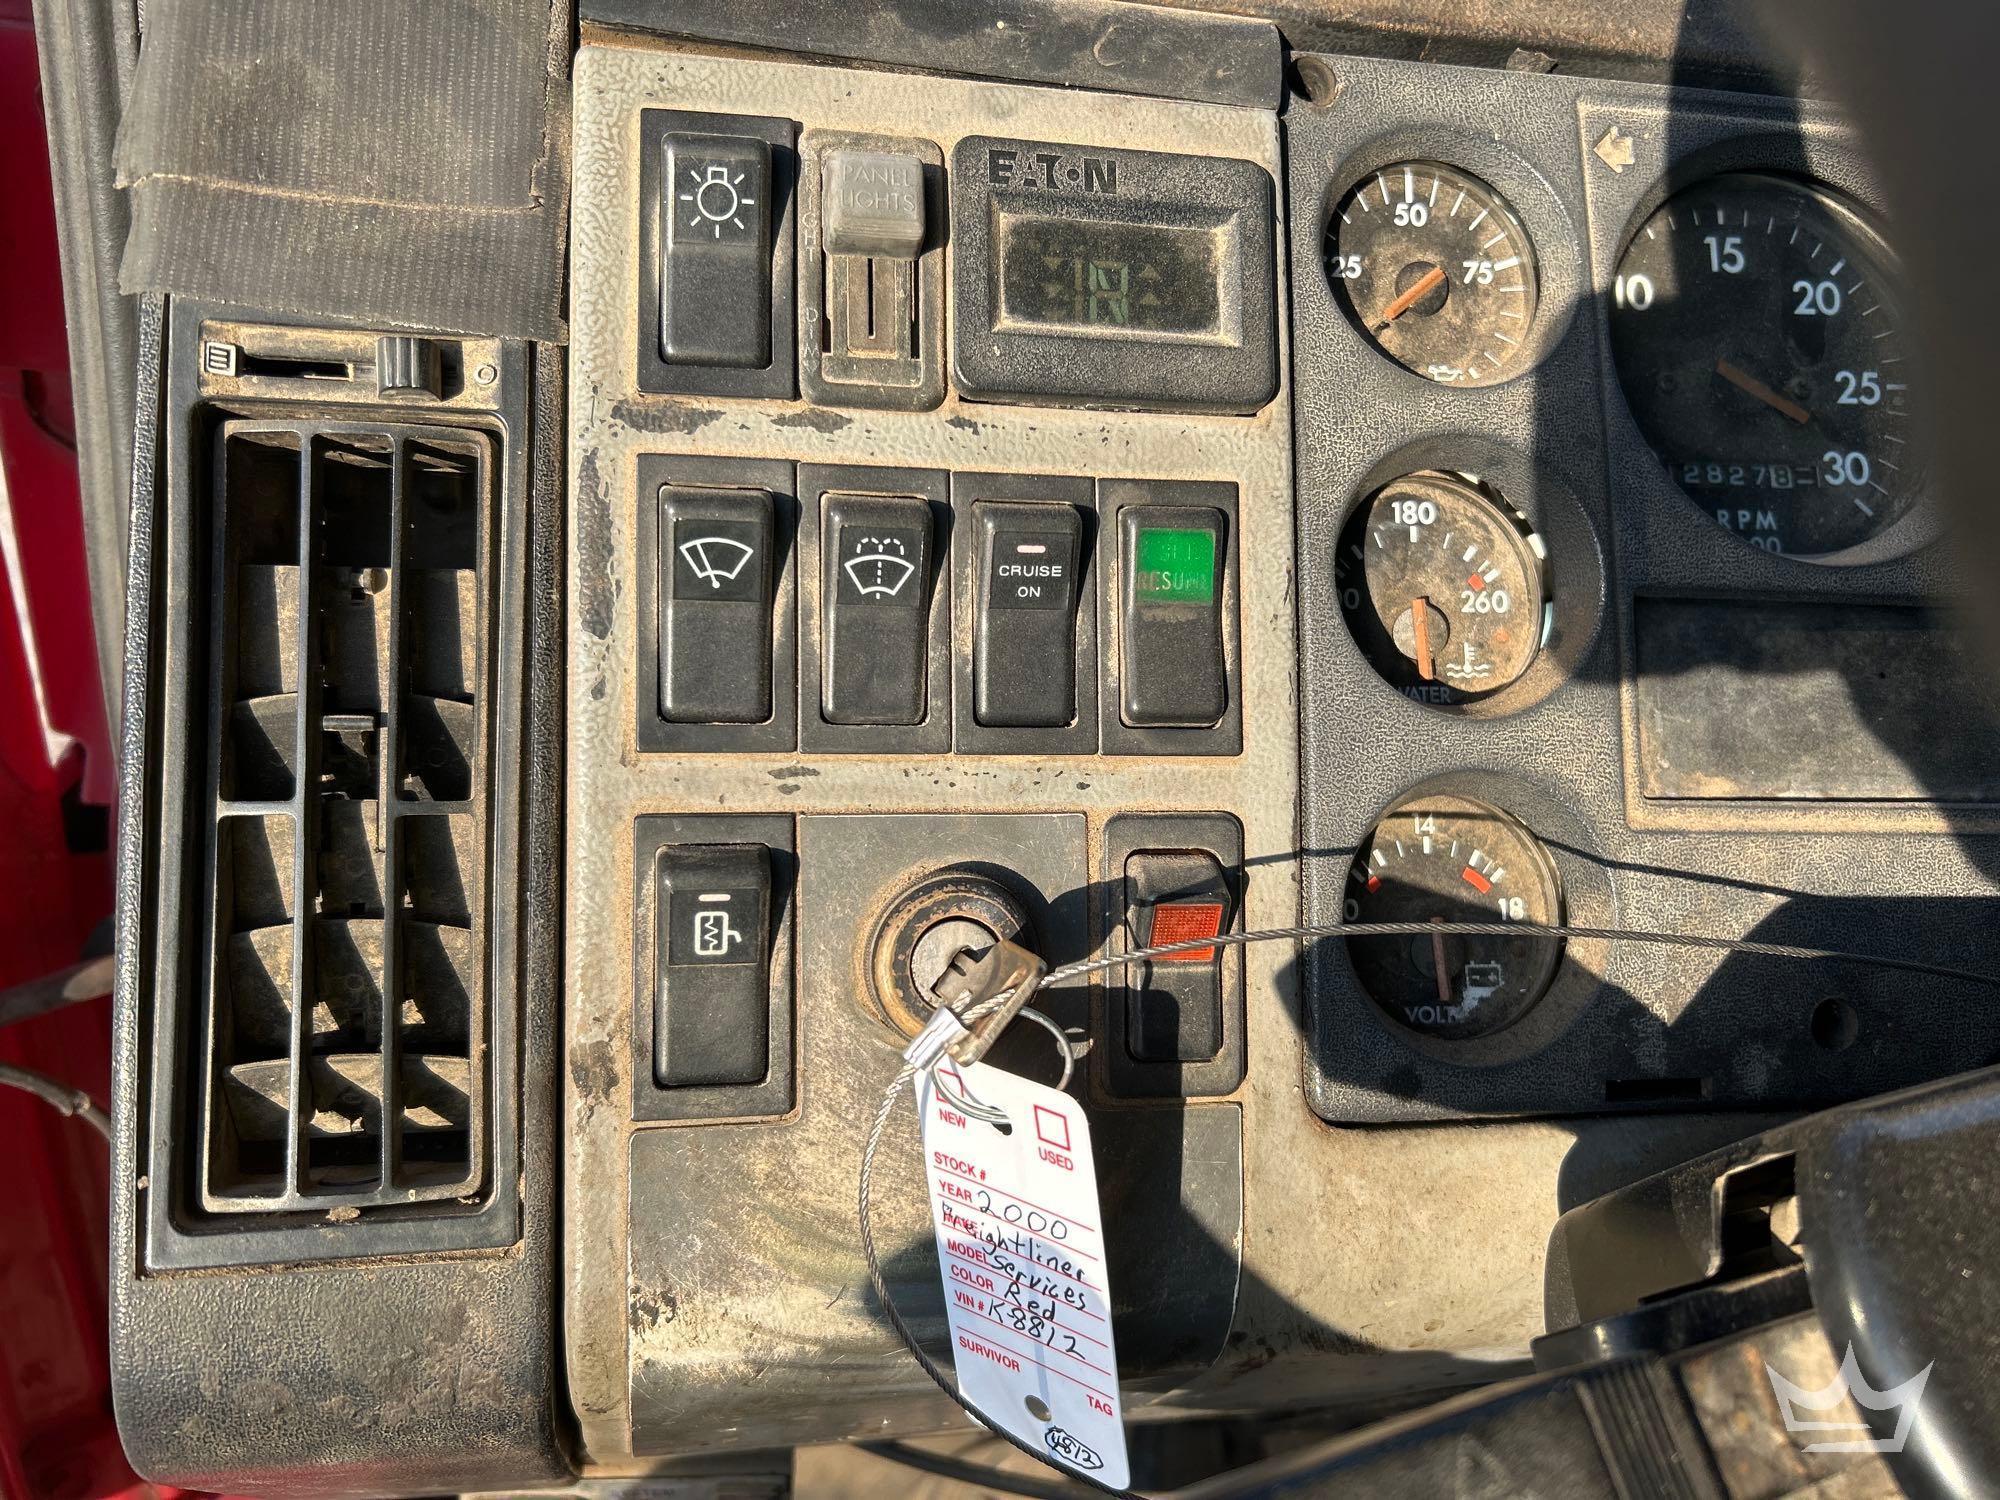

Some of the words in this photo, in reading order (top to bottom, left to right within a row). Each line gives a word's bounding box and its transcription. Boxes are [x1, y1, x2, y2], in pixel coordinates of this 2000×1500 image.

[842, 164, 911, 188] PANEL
[988, 150, 1117, 194] EATON
[839, 192, 915, 213] LIGHTS
[1393, 202, 1428, 228] 50
[1330, 255, 1362, 280] 25
[1702, 235, 1746, 275] 15
[1462, 260, 1495, 285] 75
[1615, 273, 1653, 311] 10
[1791, 279, 1840, 317] 20
[1834, 370, 1880, 406] 25
[1822, 451, 1870, 487] 30
[1391, 500, 1437, 526] 180
[998, 564, 1063, 578] CRUISE
[1017, 585, 1041, 598] ON
[1460, 590, 1509, 614] 260
[1413, 812, 1436, 835] 14
[1497, 897, 1525, 921] 18
[1404, 1005, 1463, 1025] VOLT
[938, 1108, 967, 1129] NEW
[934, 1151, 977, 1179] STOCK
[979, 1169, 987, 1182] #
[1037, 1146, 1074, 1171] USED
[938, 1179, 973, 1203] YEAR
[977, 1190, 1068, 1240] 2000
[947, 1238, 989, 1265] MODEL
[951, 1264, 995, 1292] COLOR
[954, 1289, 976, 1308] VIN
[977, 1299, 985, 1313] #
[1004, 1281, 1056, 1322] Red
[959, 1336, 1021, 1373] SURVIVOR
[1086, 1394, 1114, 1417] TAG
